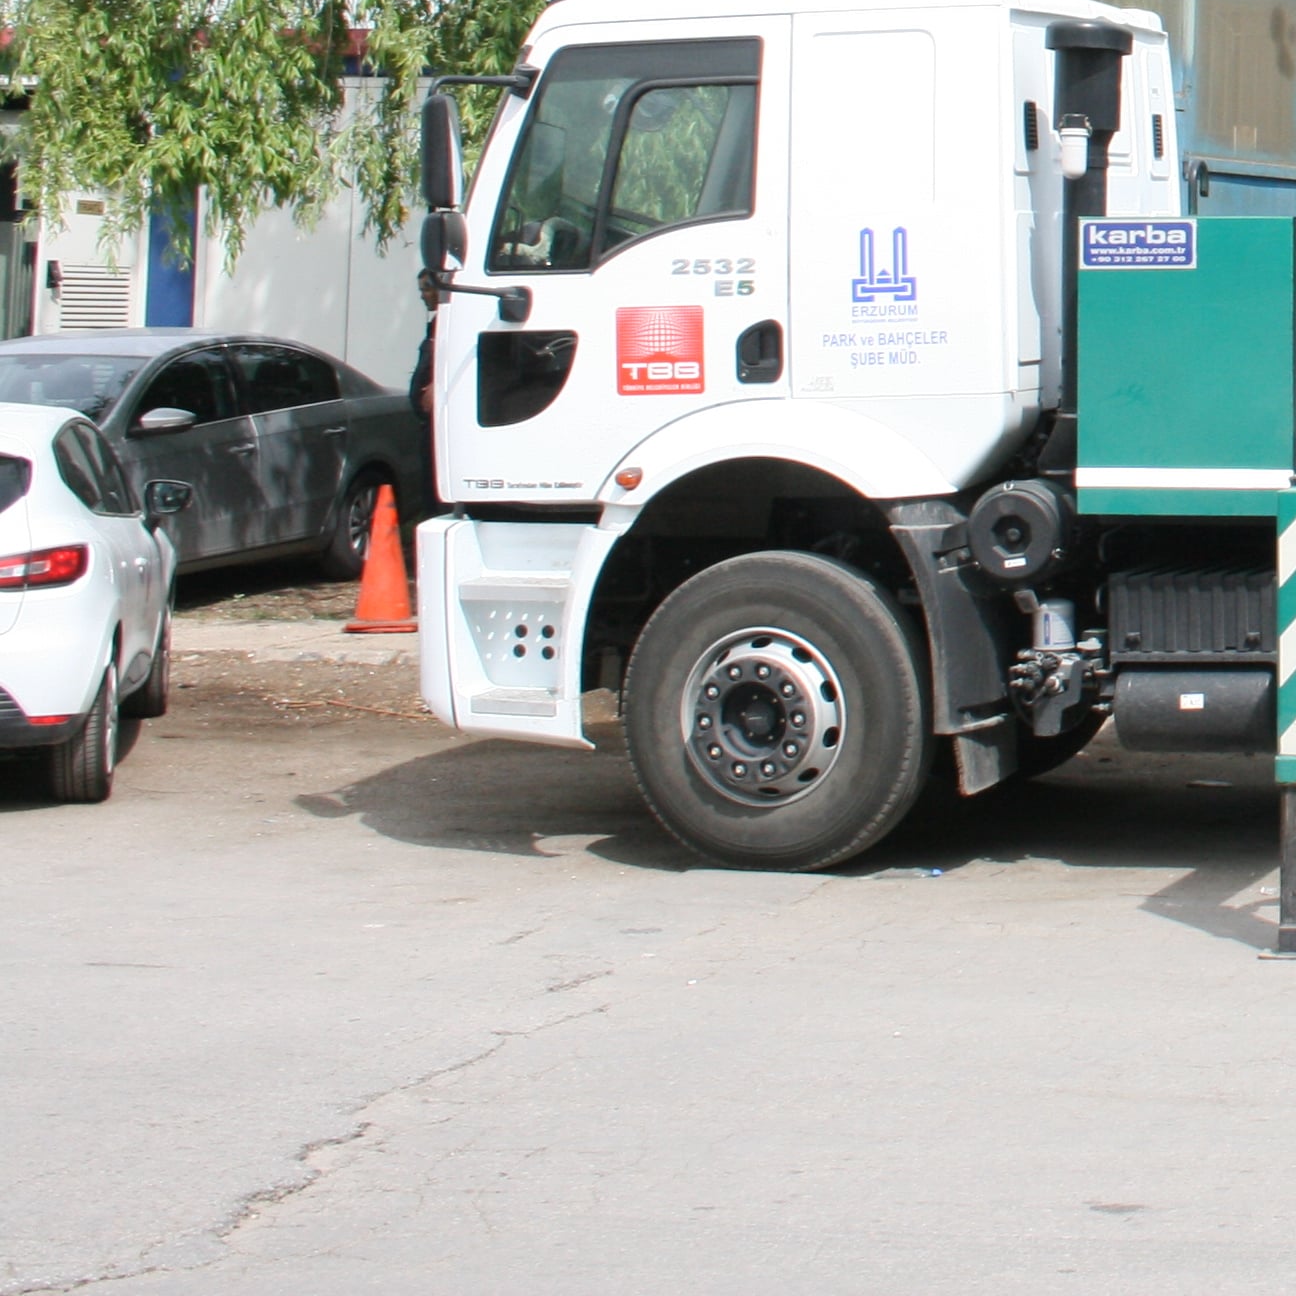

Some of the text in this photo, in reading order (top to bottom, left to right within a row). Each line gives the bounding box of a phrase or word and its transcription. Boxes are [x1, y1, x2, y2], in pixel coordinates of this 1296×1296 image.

[1089, 225, 1187, 245] karba
[1089, 246, 1187, 255] www.karba.com.tr
[671, 257, 756, 275] 2532
[714, 279, 756, 297] E5
[851, 304, 919, 318] ERZURUM
[822, 331, 948, 349] PARK ve BAHÇELER
[850, 349, 921, 369] ŞUBE MÜD.
[622, 362, 700, 380] TBB
[463, 479, 505, 489] TBB
